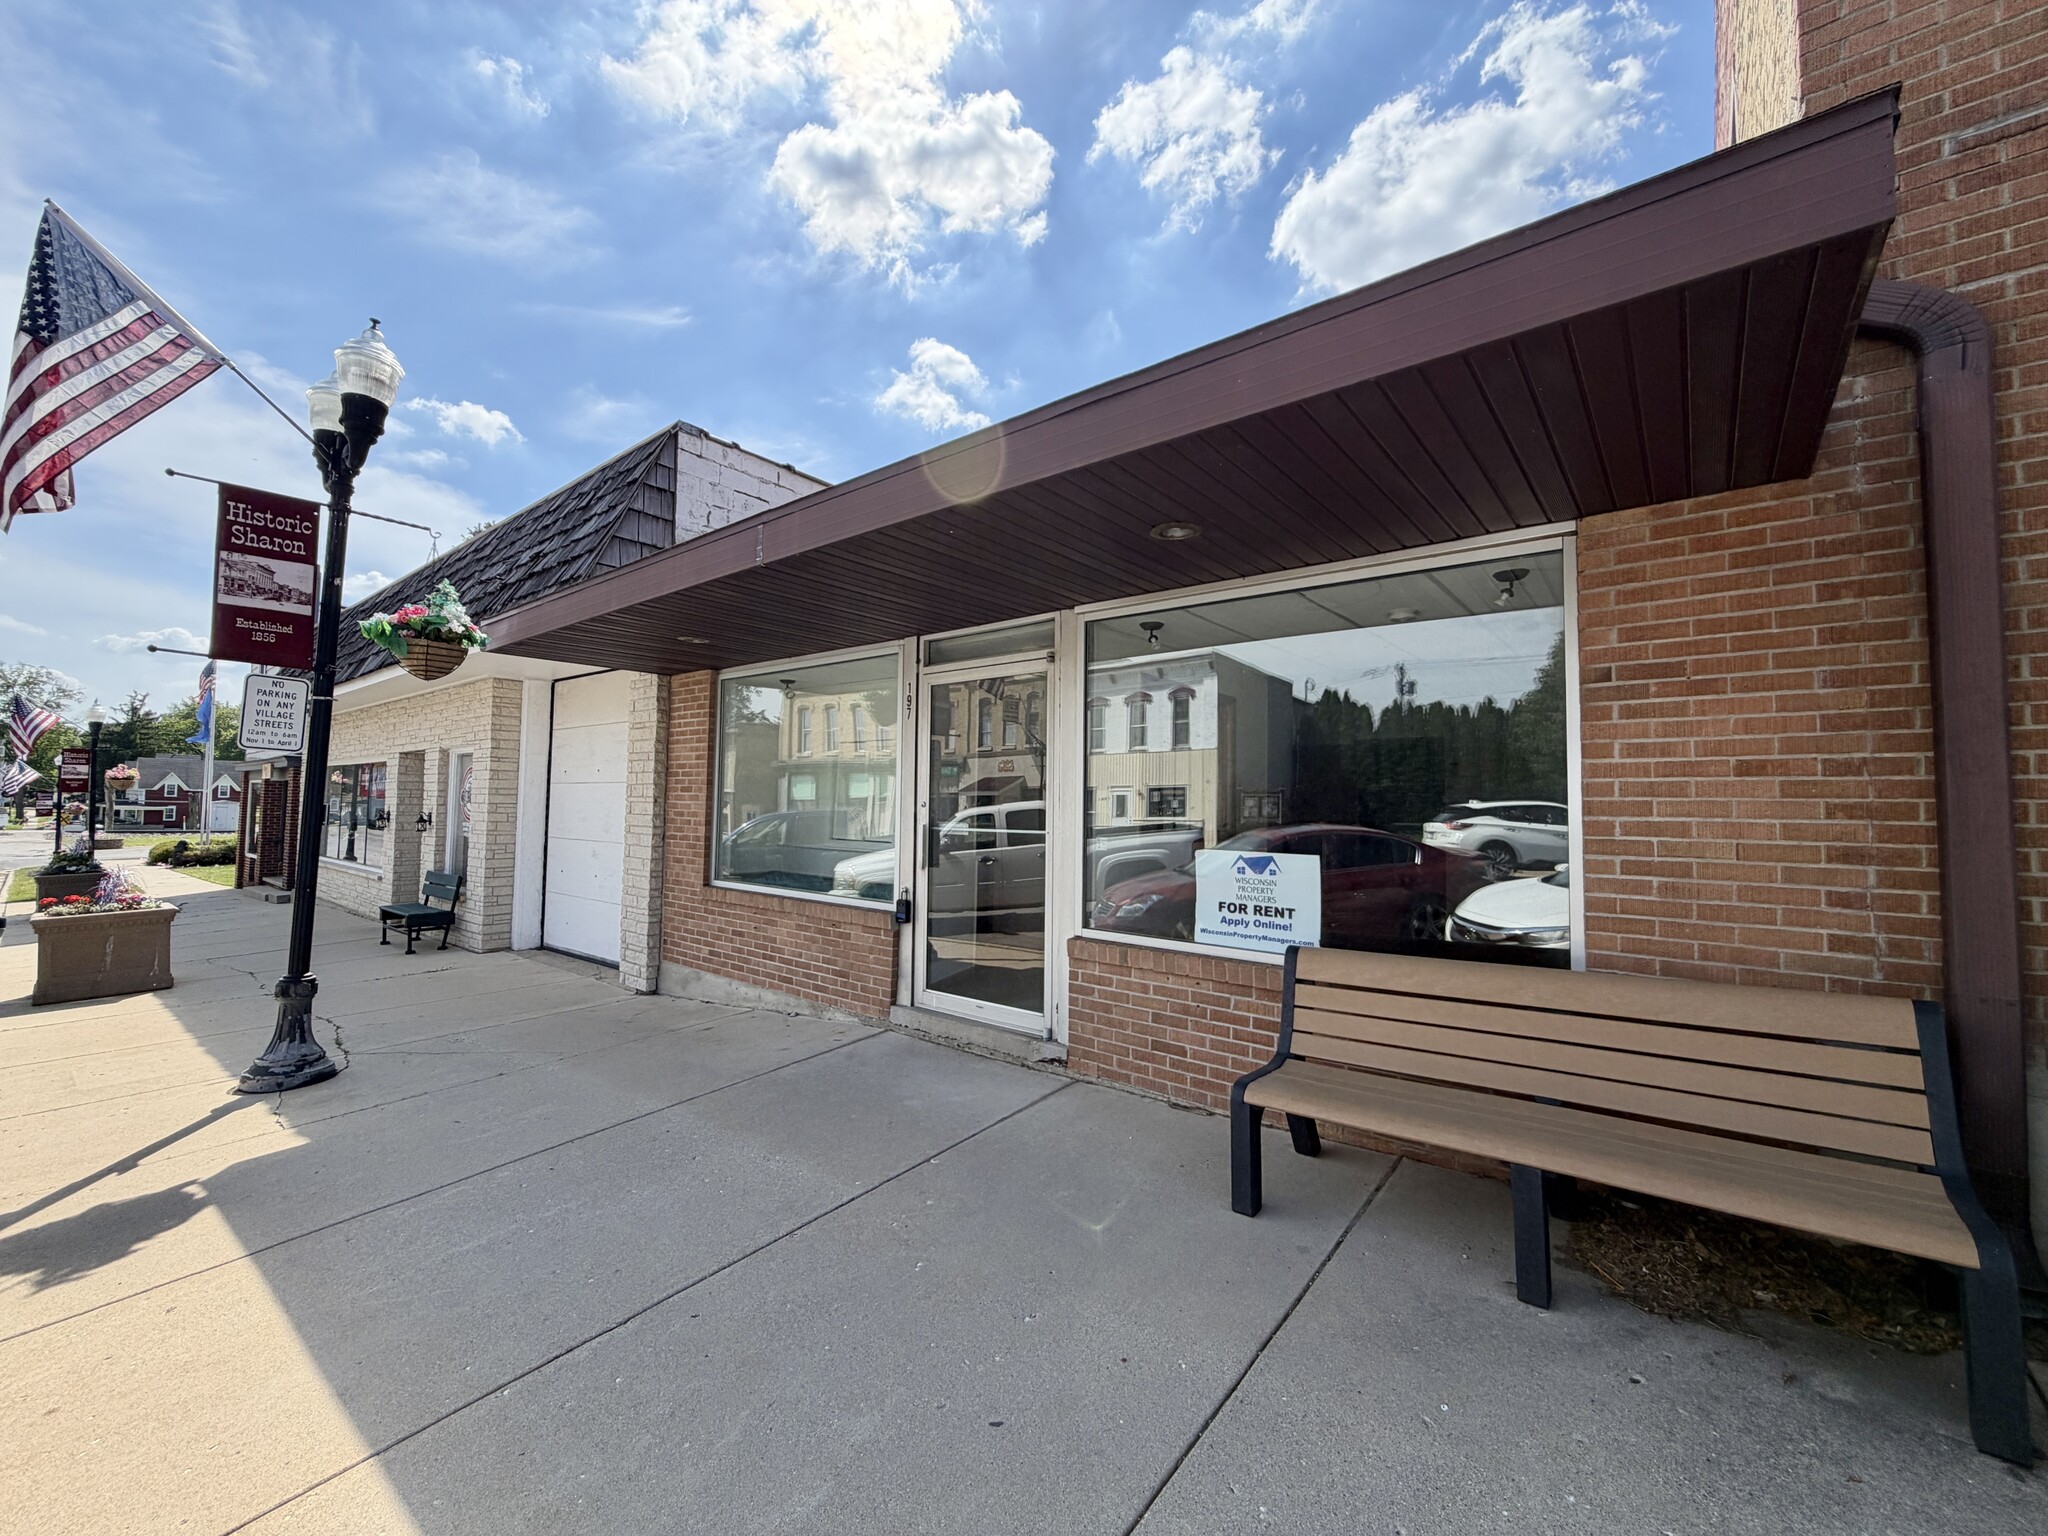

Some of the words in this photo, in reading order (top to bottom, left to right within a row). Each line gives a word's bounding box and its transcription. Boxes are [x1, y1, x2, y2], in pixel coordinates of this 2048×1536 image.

[226, 500, 313, 535] Historic
[231, 525, 306, 555] Sharon
[235, 617, 293, 634] Established
[251, 631, 276, 643] 1856
[271, 680, 285, 688] NO
[256, 688, 298, 700] PARKING
[257, 699, 270, 707] ON
[276, 701, 295, 710] ANY
[255, 709, 295, 720] VILLAGE
[254, 719, 294, 730] STREETS
[1235, 876, 1277, 887] WISCONSIN
[1237, 886, 1274, 895] PROPERTY
[1235, 893, 1277, 904] MANAGERS
[1218, 901, 1248, 915] FOR
[1253, 904, 1296, 920] RENT
[1220, 915, 1250, 929] Apply
[1253, 919, 1293, 932] Online!
[1199, 927, 1315, 947] WisconsinPropertyManagers.com
